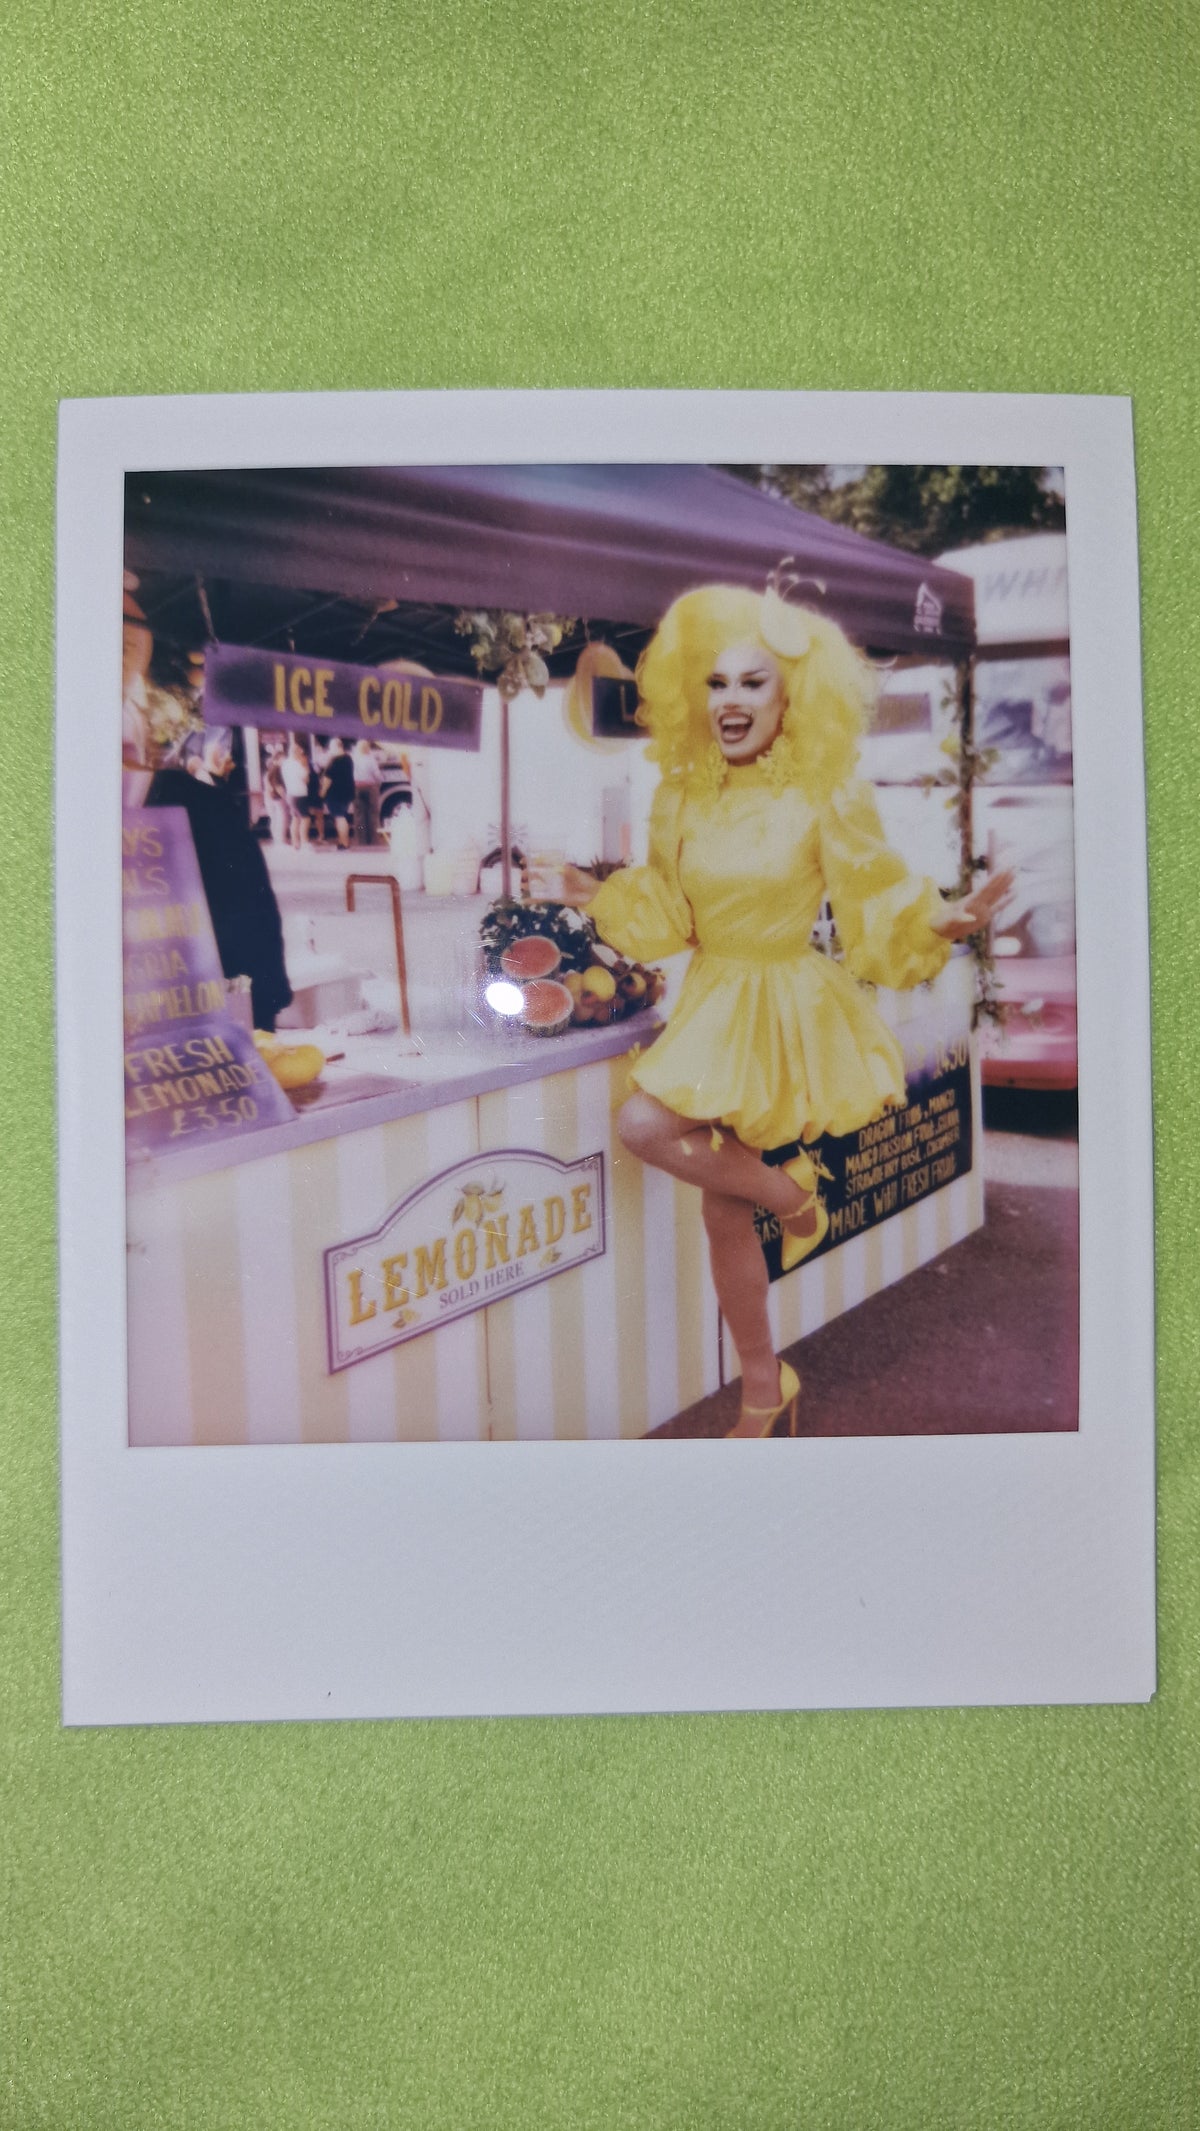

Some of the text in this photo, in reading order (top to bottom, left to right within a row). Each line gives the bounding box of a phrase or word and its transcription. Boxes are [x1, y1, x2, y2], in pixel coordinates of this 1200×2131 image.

[273, 663, 443, 734] ICE COLD
[124, 1035, 235, 1083] FRESH
[830, 1196, 868, 1241] MADE
[874, 1179, 898, 1218] WITH
[901, 1163, 929, 1204] FRESH
[932, 1151, 957, 1186] FRUIT
[347, 1183, 592, 1327] LEMONADE
[439, 1262, 525, 1310] SOLD HERE
